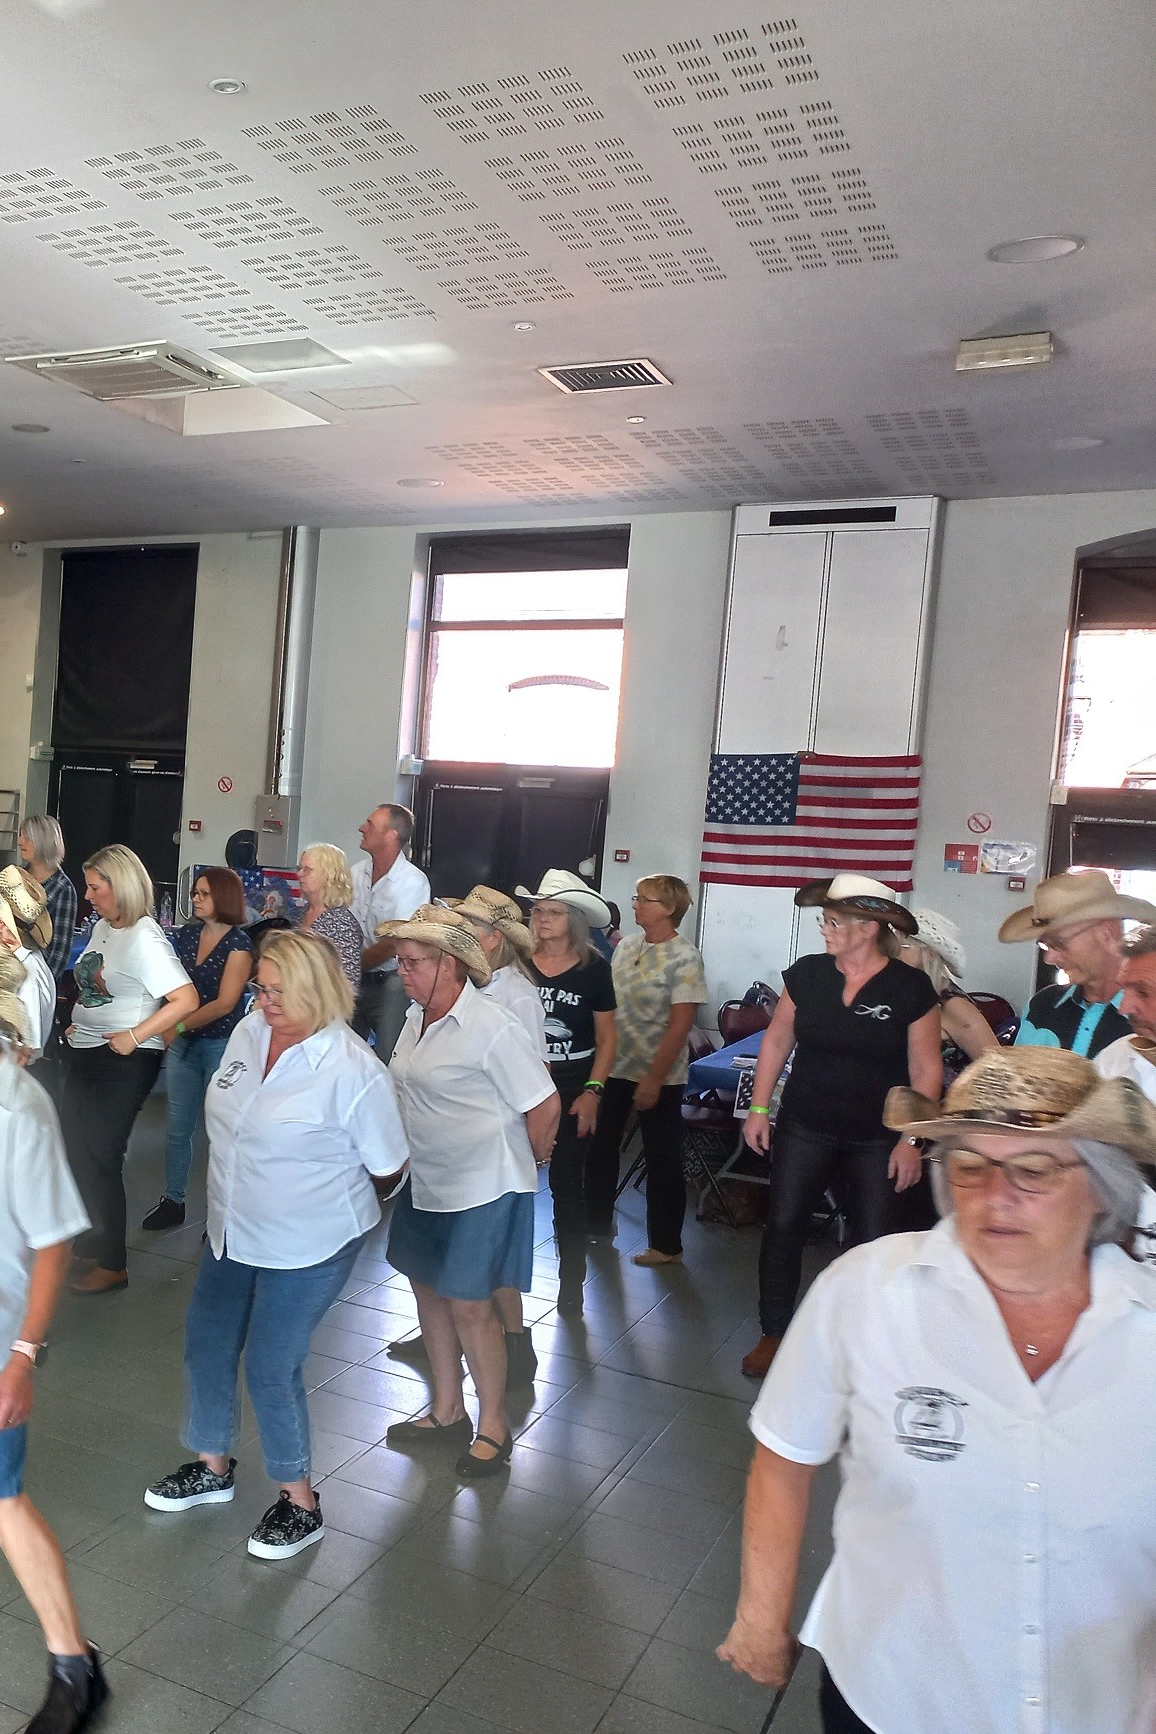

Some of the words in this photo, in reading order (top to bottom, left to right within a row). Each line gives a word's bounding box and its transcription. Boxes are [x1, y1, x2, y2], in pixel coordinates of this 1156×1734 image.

[536, 986, 555, 1000] UX
[556, 989, 582, 1006] PAS
[543, 1000, 555, 1013] AI
[546, 1040, 573, 1055] TRY
